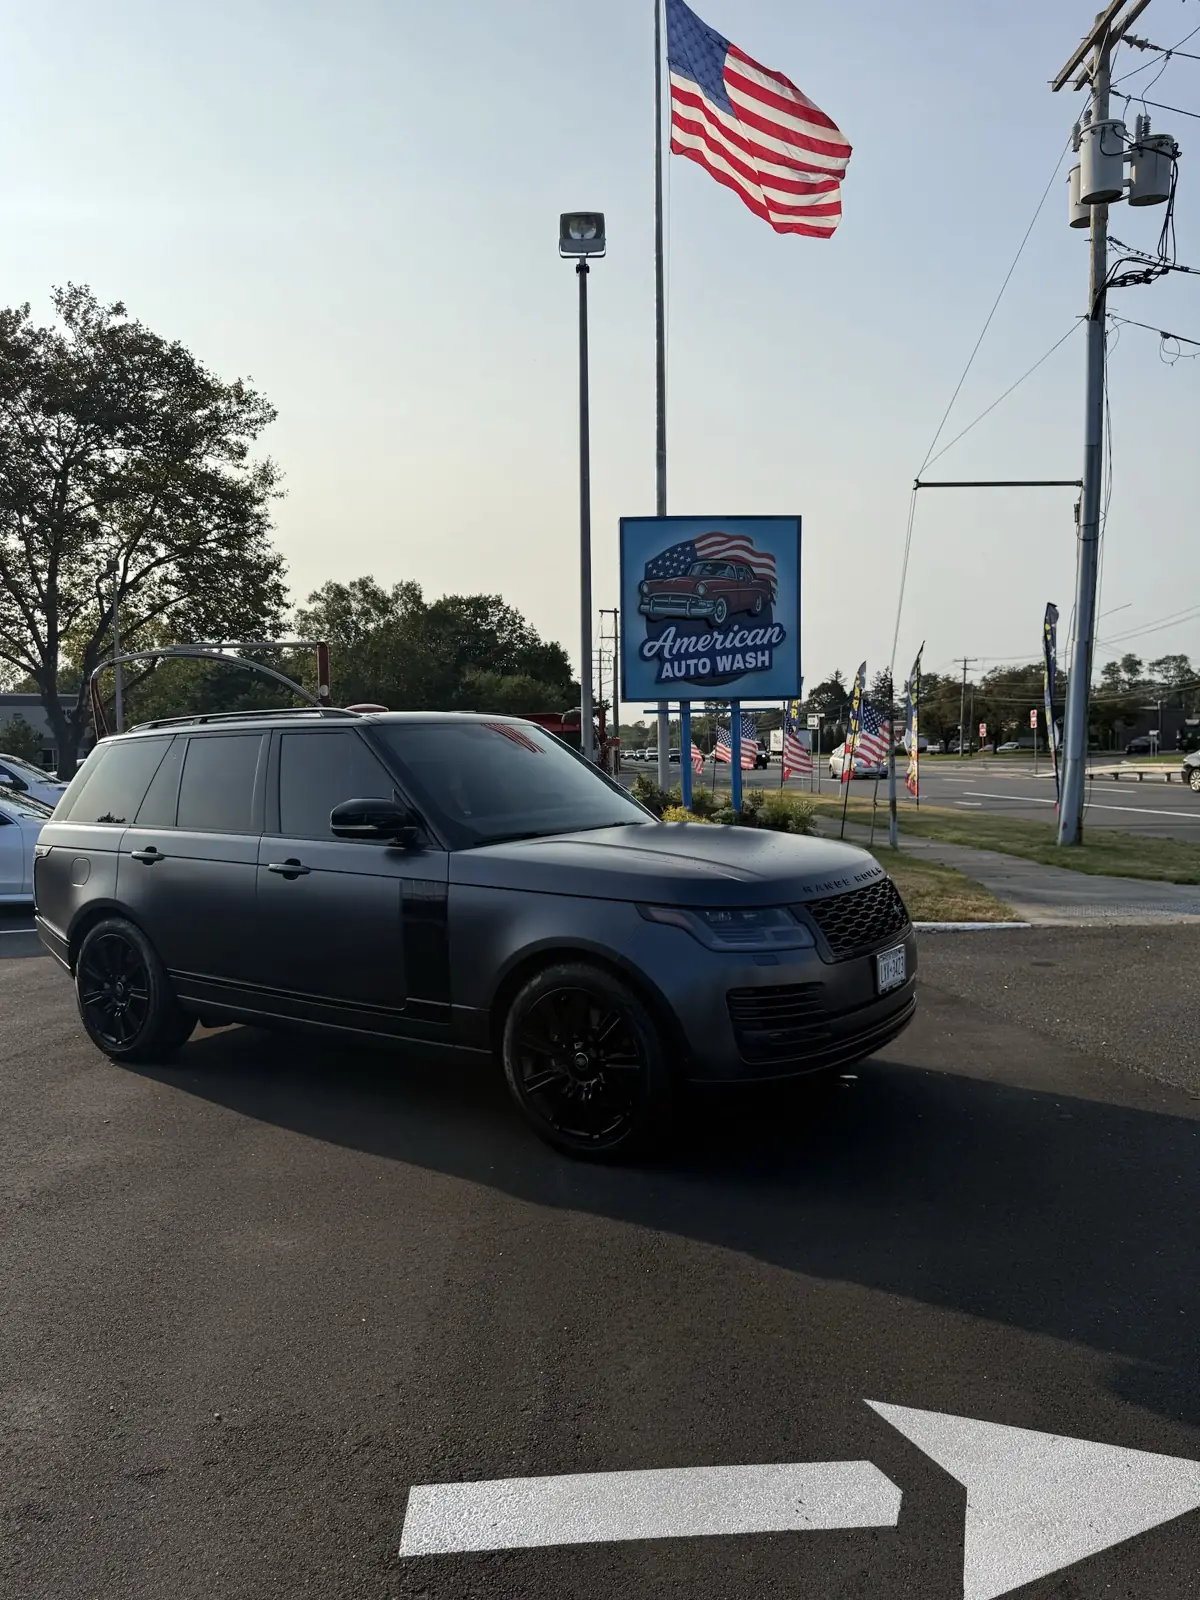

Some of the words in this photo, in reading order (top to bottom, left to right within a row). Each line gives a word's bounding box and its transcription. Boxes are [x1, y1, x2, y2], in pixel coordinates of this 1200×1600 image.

[643, 625, 783, 658] American
[661, 658, 711, 679] AUTO
[716, 650, 770, 672] WASH
[802, 877, 851, 894] RANGE
[853, 867, 882, 883] ROVER
